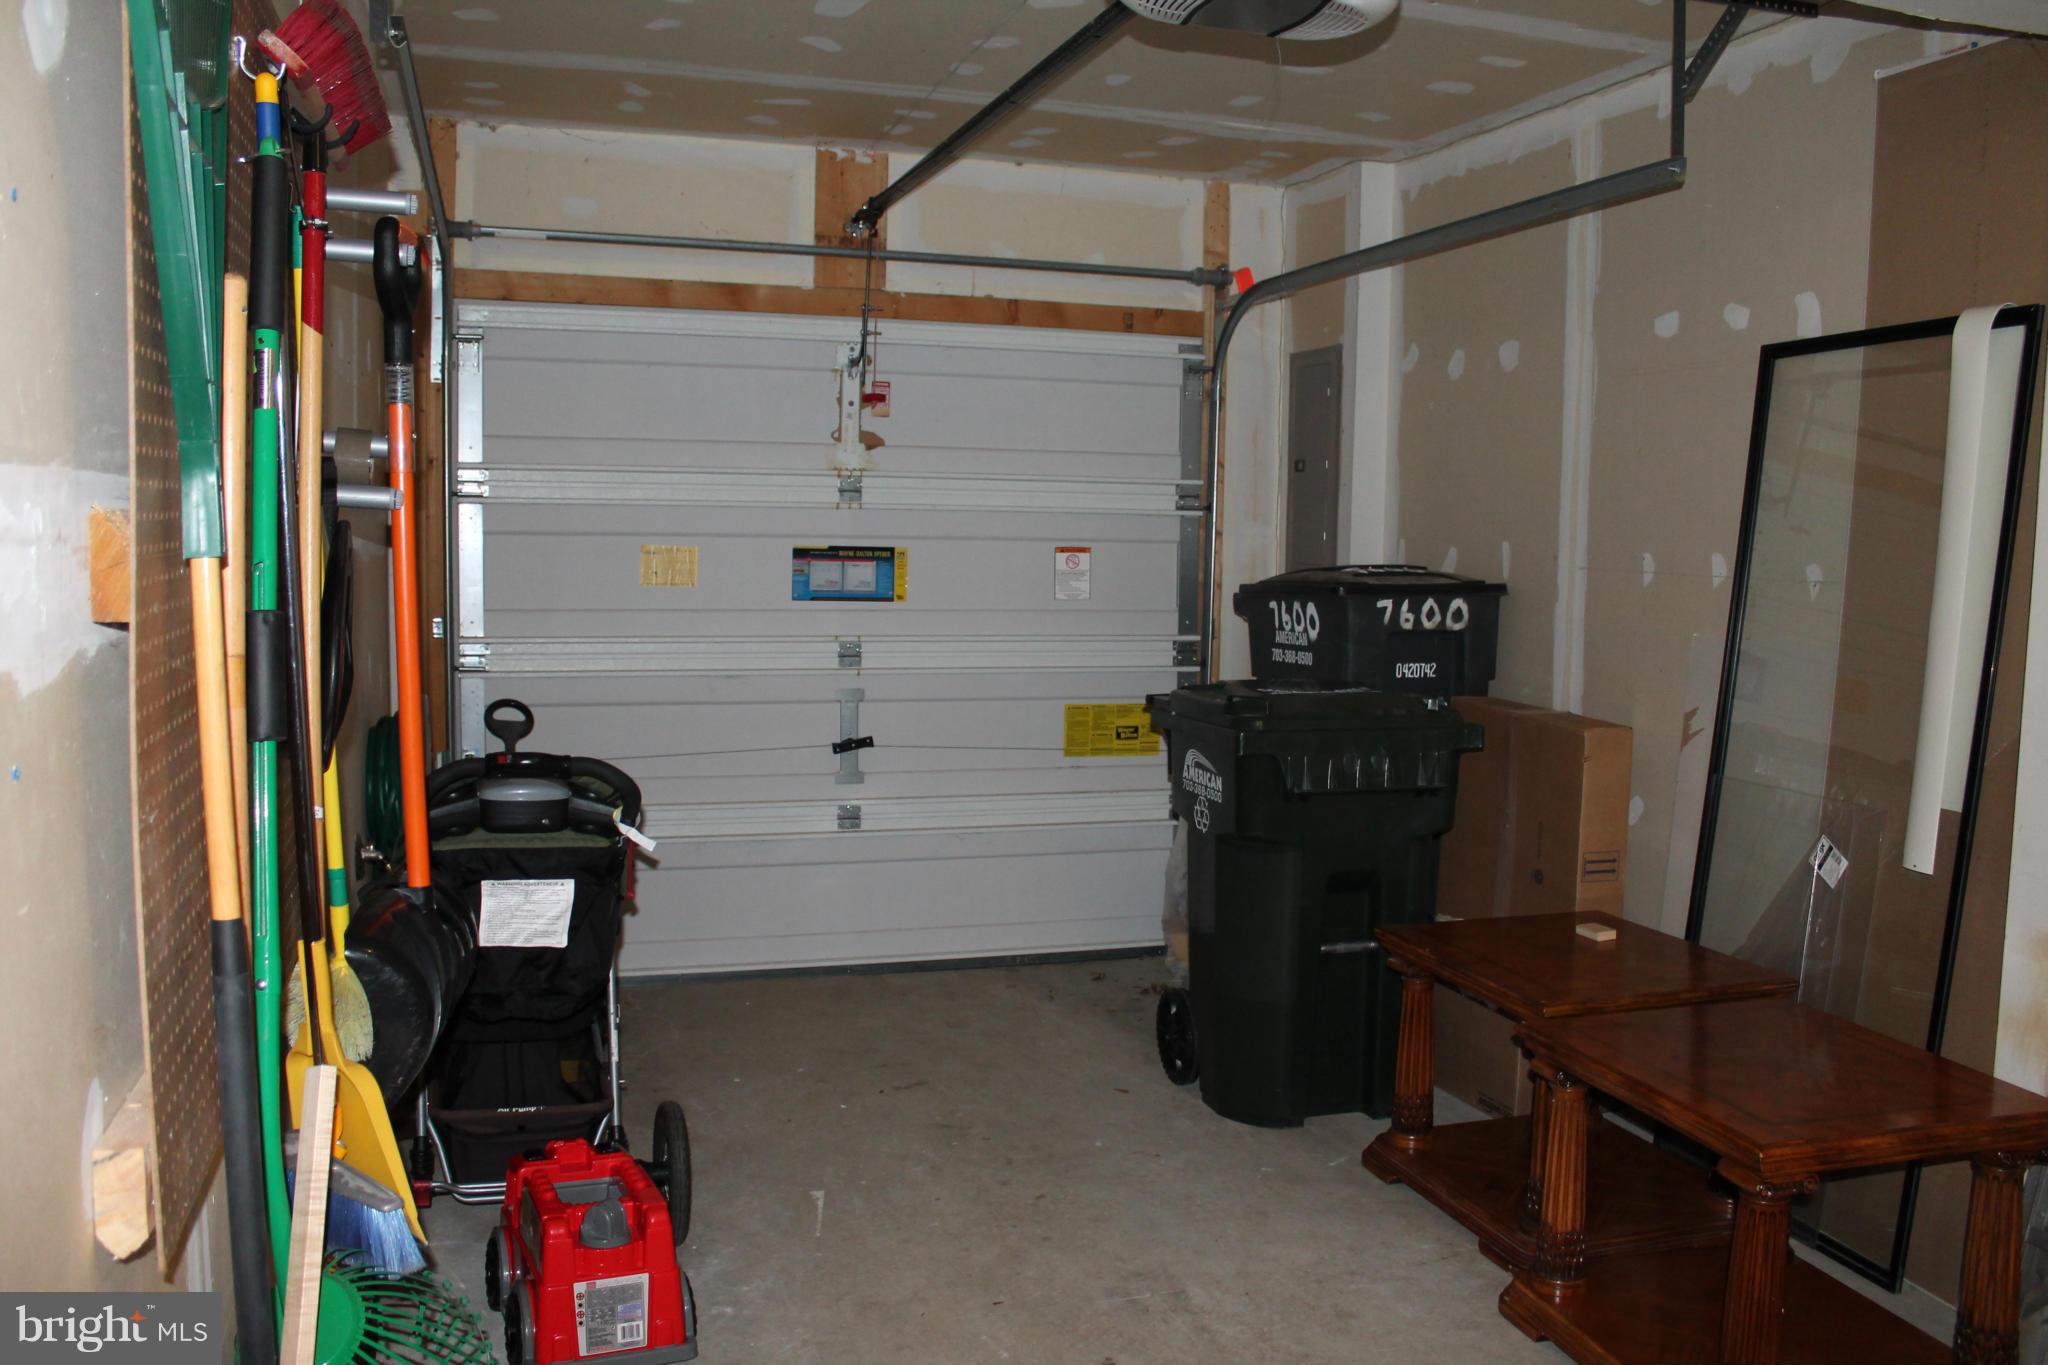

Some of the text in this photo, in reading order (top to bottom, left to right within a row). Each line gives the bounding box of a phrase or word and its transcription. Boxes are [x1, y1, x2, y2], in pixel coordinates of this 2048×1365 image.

[1376, 597, 1469, 631] 7600
[1275, 630, 1308, 646] AMERICAN
[1395, 662, 1437, 679] 0420742
[1182, 765, 1223, 792] AMERICAN
